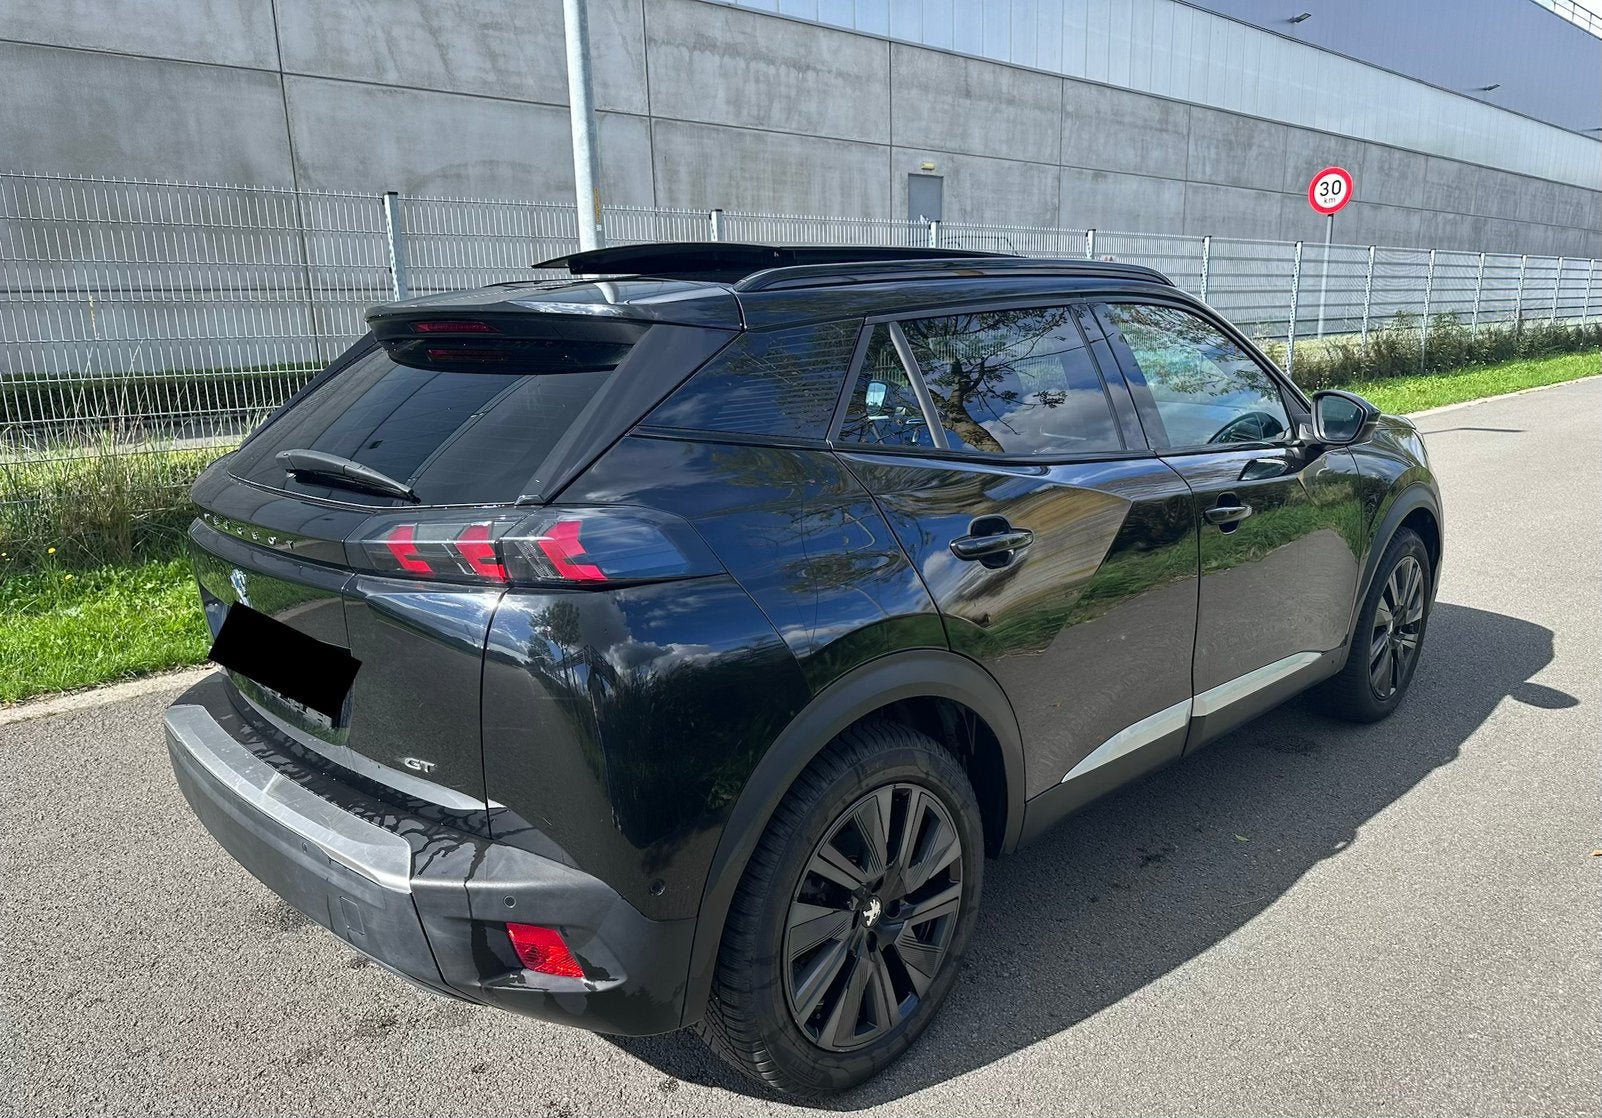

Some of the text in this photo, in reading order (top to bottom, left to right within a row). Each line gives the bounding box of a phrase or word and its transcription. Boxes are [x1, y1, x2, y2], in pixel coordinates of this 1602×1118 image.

[1319, 179, 1342, 197] 30
[1323, 196, 1336, 204] km
[404, 757, 435, 773] GT
